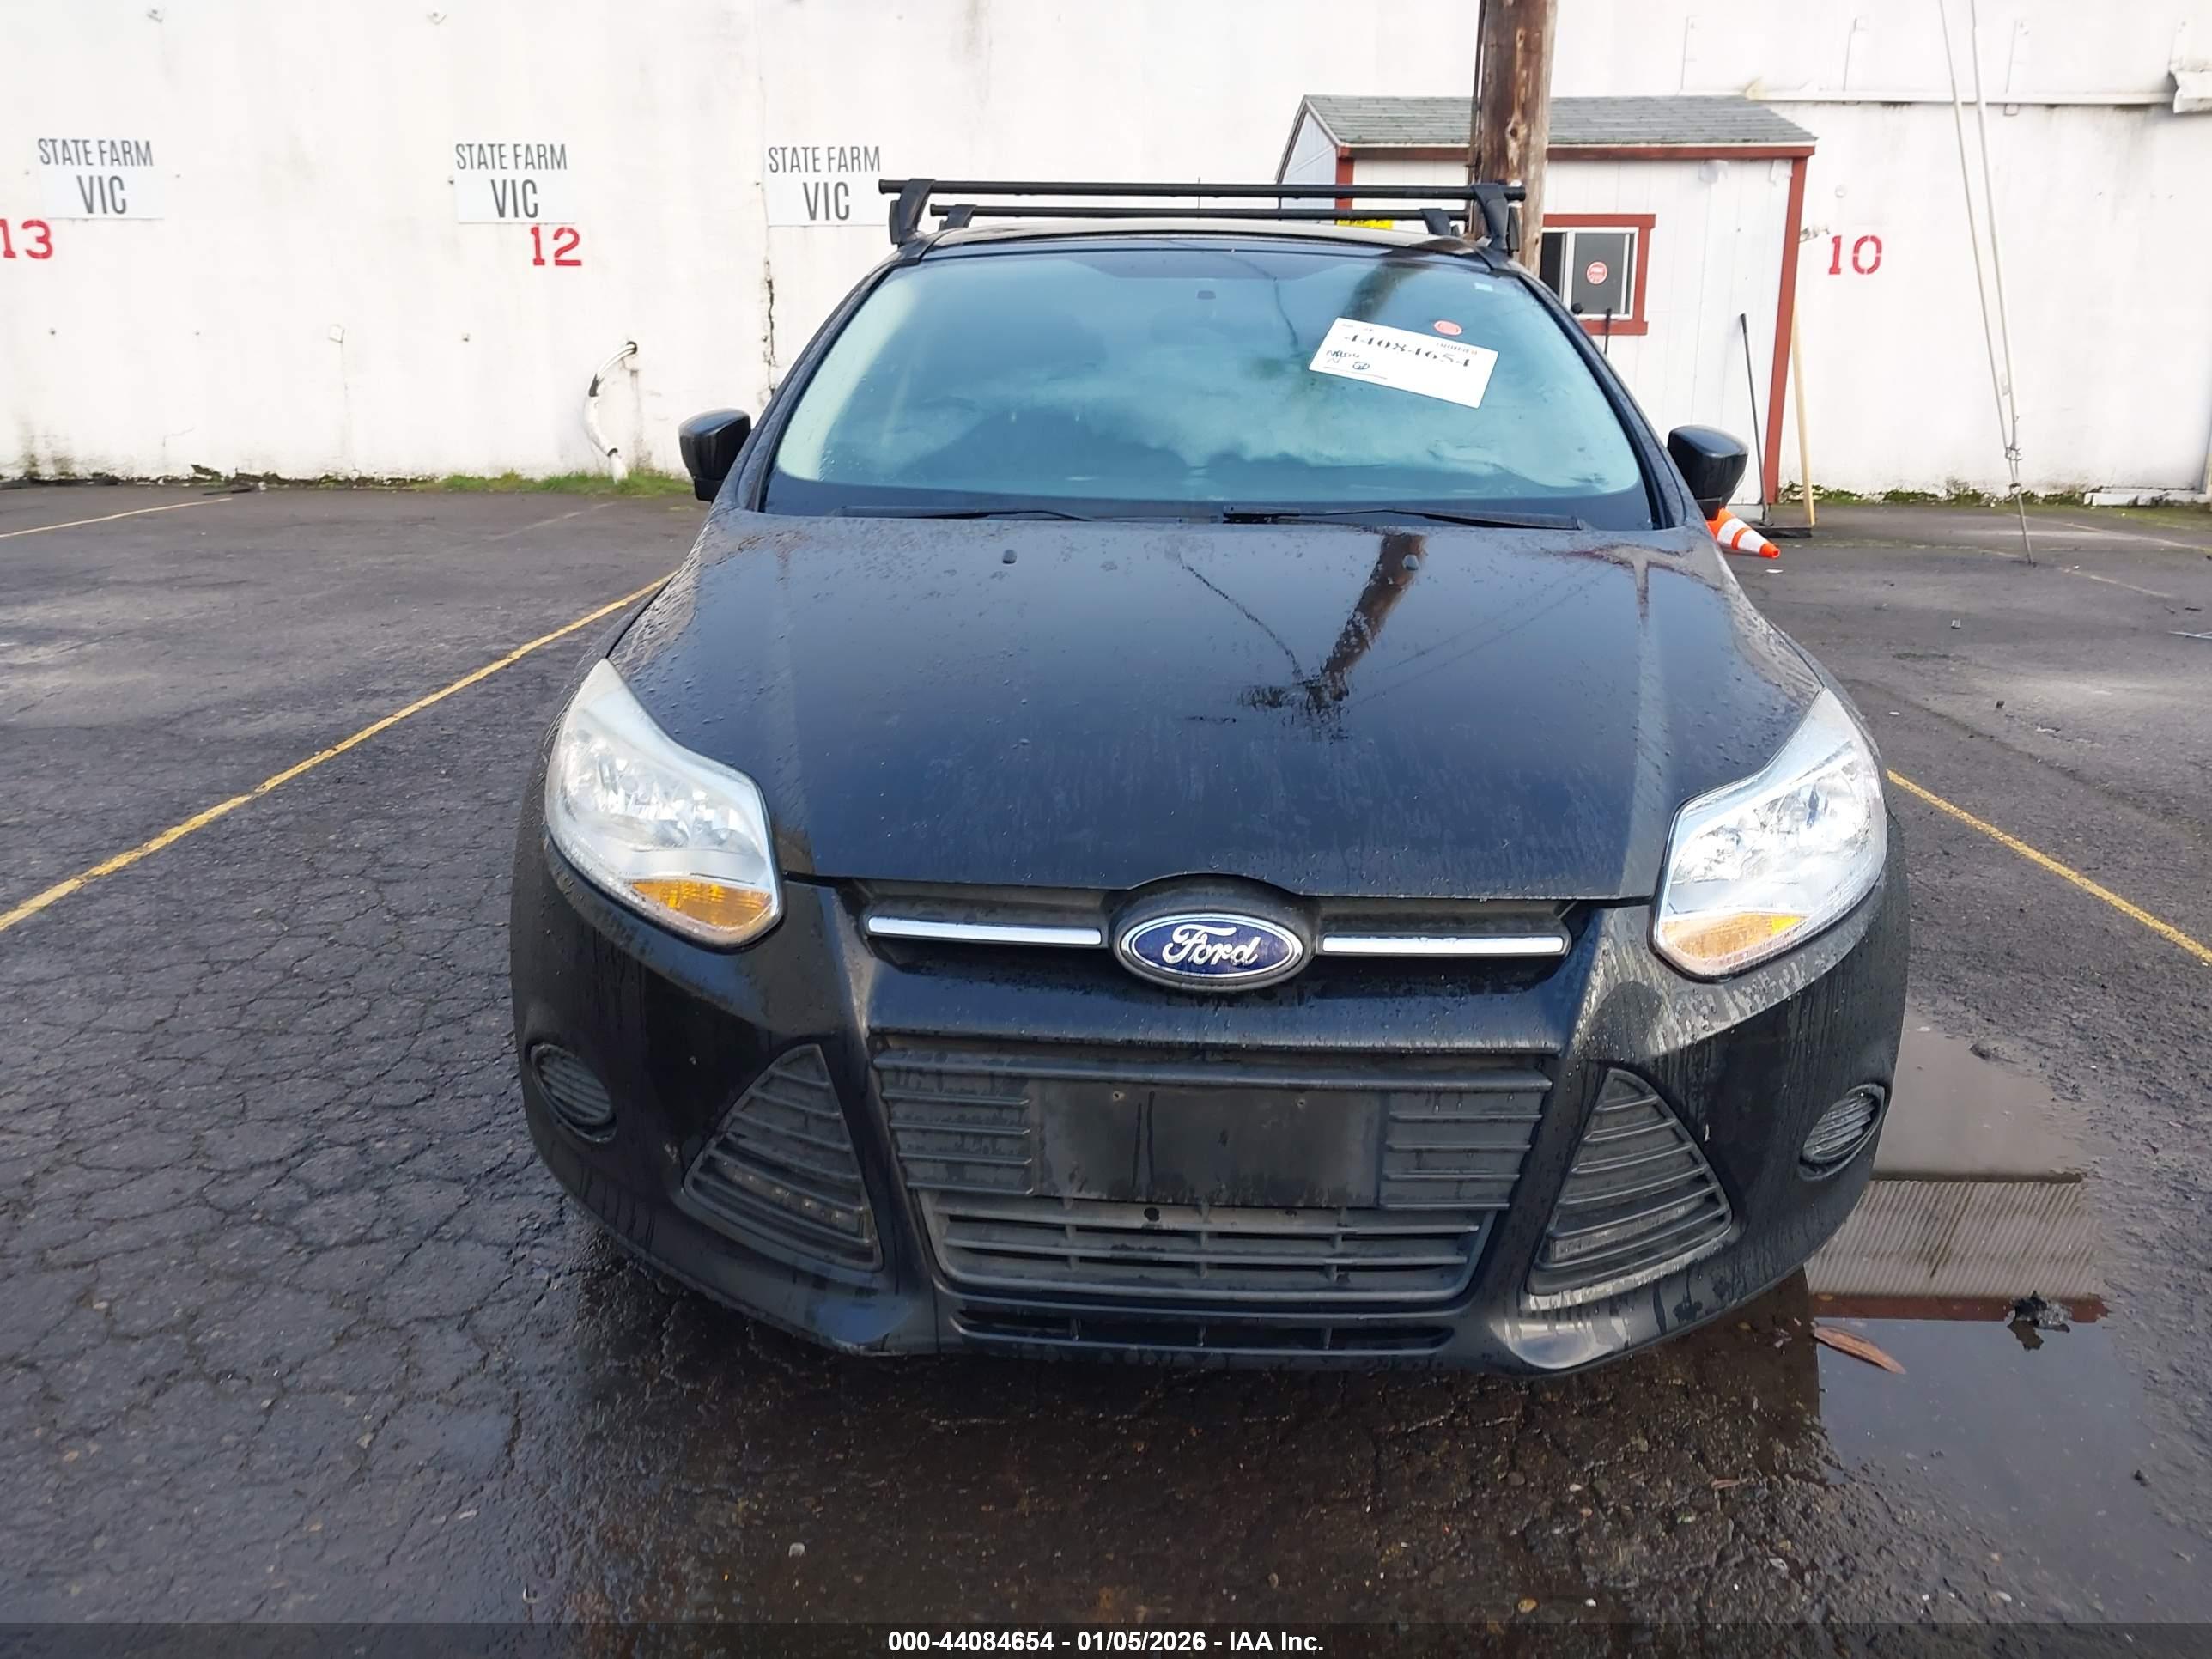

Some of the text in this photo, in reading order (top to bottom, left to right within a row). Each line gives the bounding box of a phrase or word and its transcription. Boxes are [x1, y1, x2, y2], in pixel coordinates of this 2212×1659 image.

[38, 138, 154, 167] STATE FARM
[455, 143, 568, 170] STATE FARM
[769, 146, 881, 173] STATE FARM
[76, 175, 127, 214] VIC
[490, 179, 538, 218] VIC
[803, 181, 850, 221] VIC
[0, 218, 53, 260] 13
[531, 226, 582, 266] 12
[1828, 235, 1882, 275] 10
[1162, 924, 1261, 966] Ford
